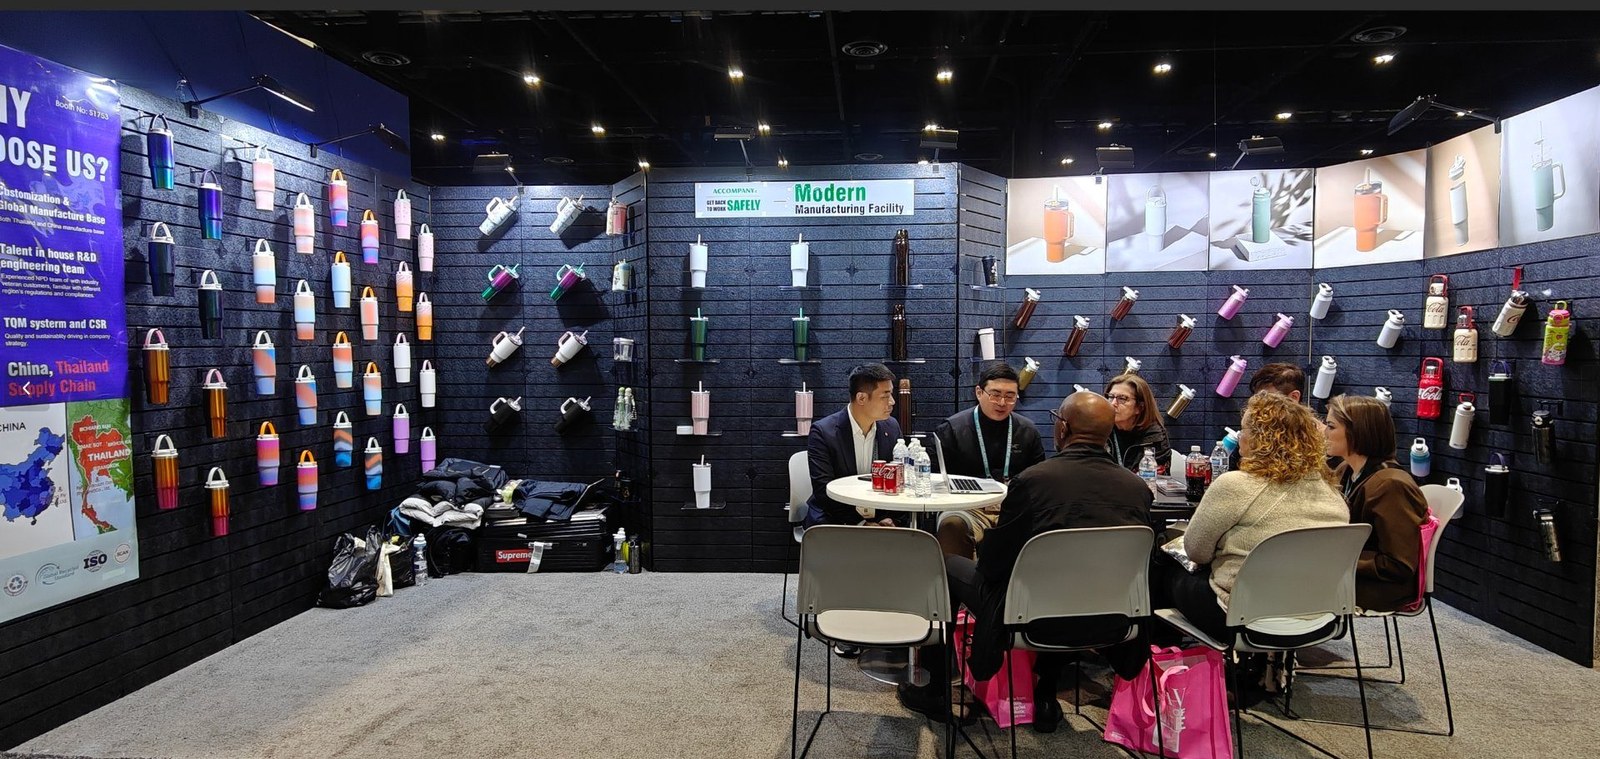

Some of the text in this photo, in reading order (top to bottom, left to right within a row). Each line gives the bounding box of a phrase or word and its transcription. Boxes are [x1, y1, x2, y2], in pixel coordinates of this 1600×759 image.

[56, 100, 75, 111] Booth
[89, 109, 109, 120] S1753
[66, 149, 109, 182] US?
[795, 183, 866, 202] Modern
[63, 197, 70, 206] &
[727, 199, 761, 211] SAFELY
[795, 203, 904, 215] Manufacturing Facility
[30, 205, 84, 222] Manufacture
[86, 213, 106, 225] Base
[0, 243, 97, 263] Talent in house R&D
[1, 258, 85, 275] engineering team
[4, 317, 107, 330] TQM systerm and CSR
[8, 360, 109, 377] China, Thailand
[60, 379, 96, 393] Chain
[1421, 386, 1442, 400] Cola
[88, 448, 132, 462] THAILAND
[83, 553, 108, 569] ISO
[498, 551, 533, 561] Supreme
